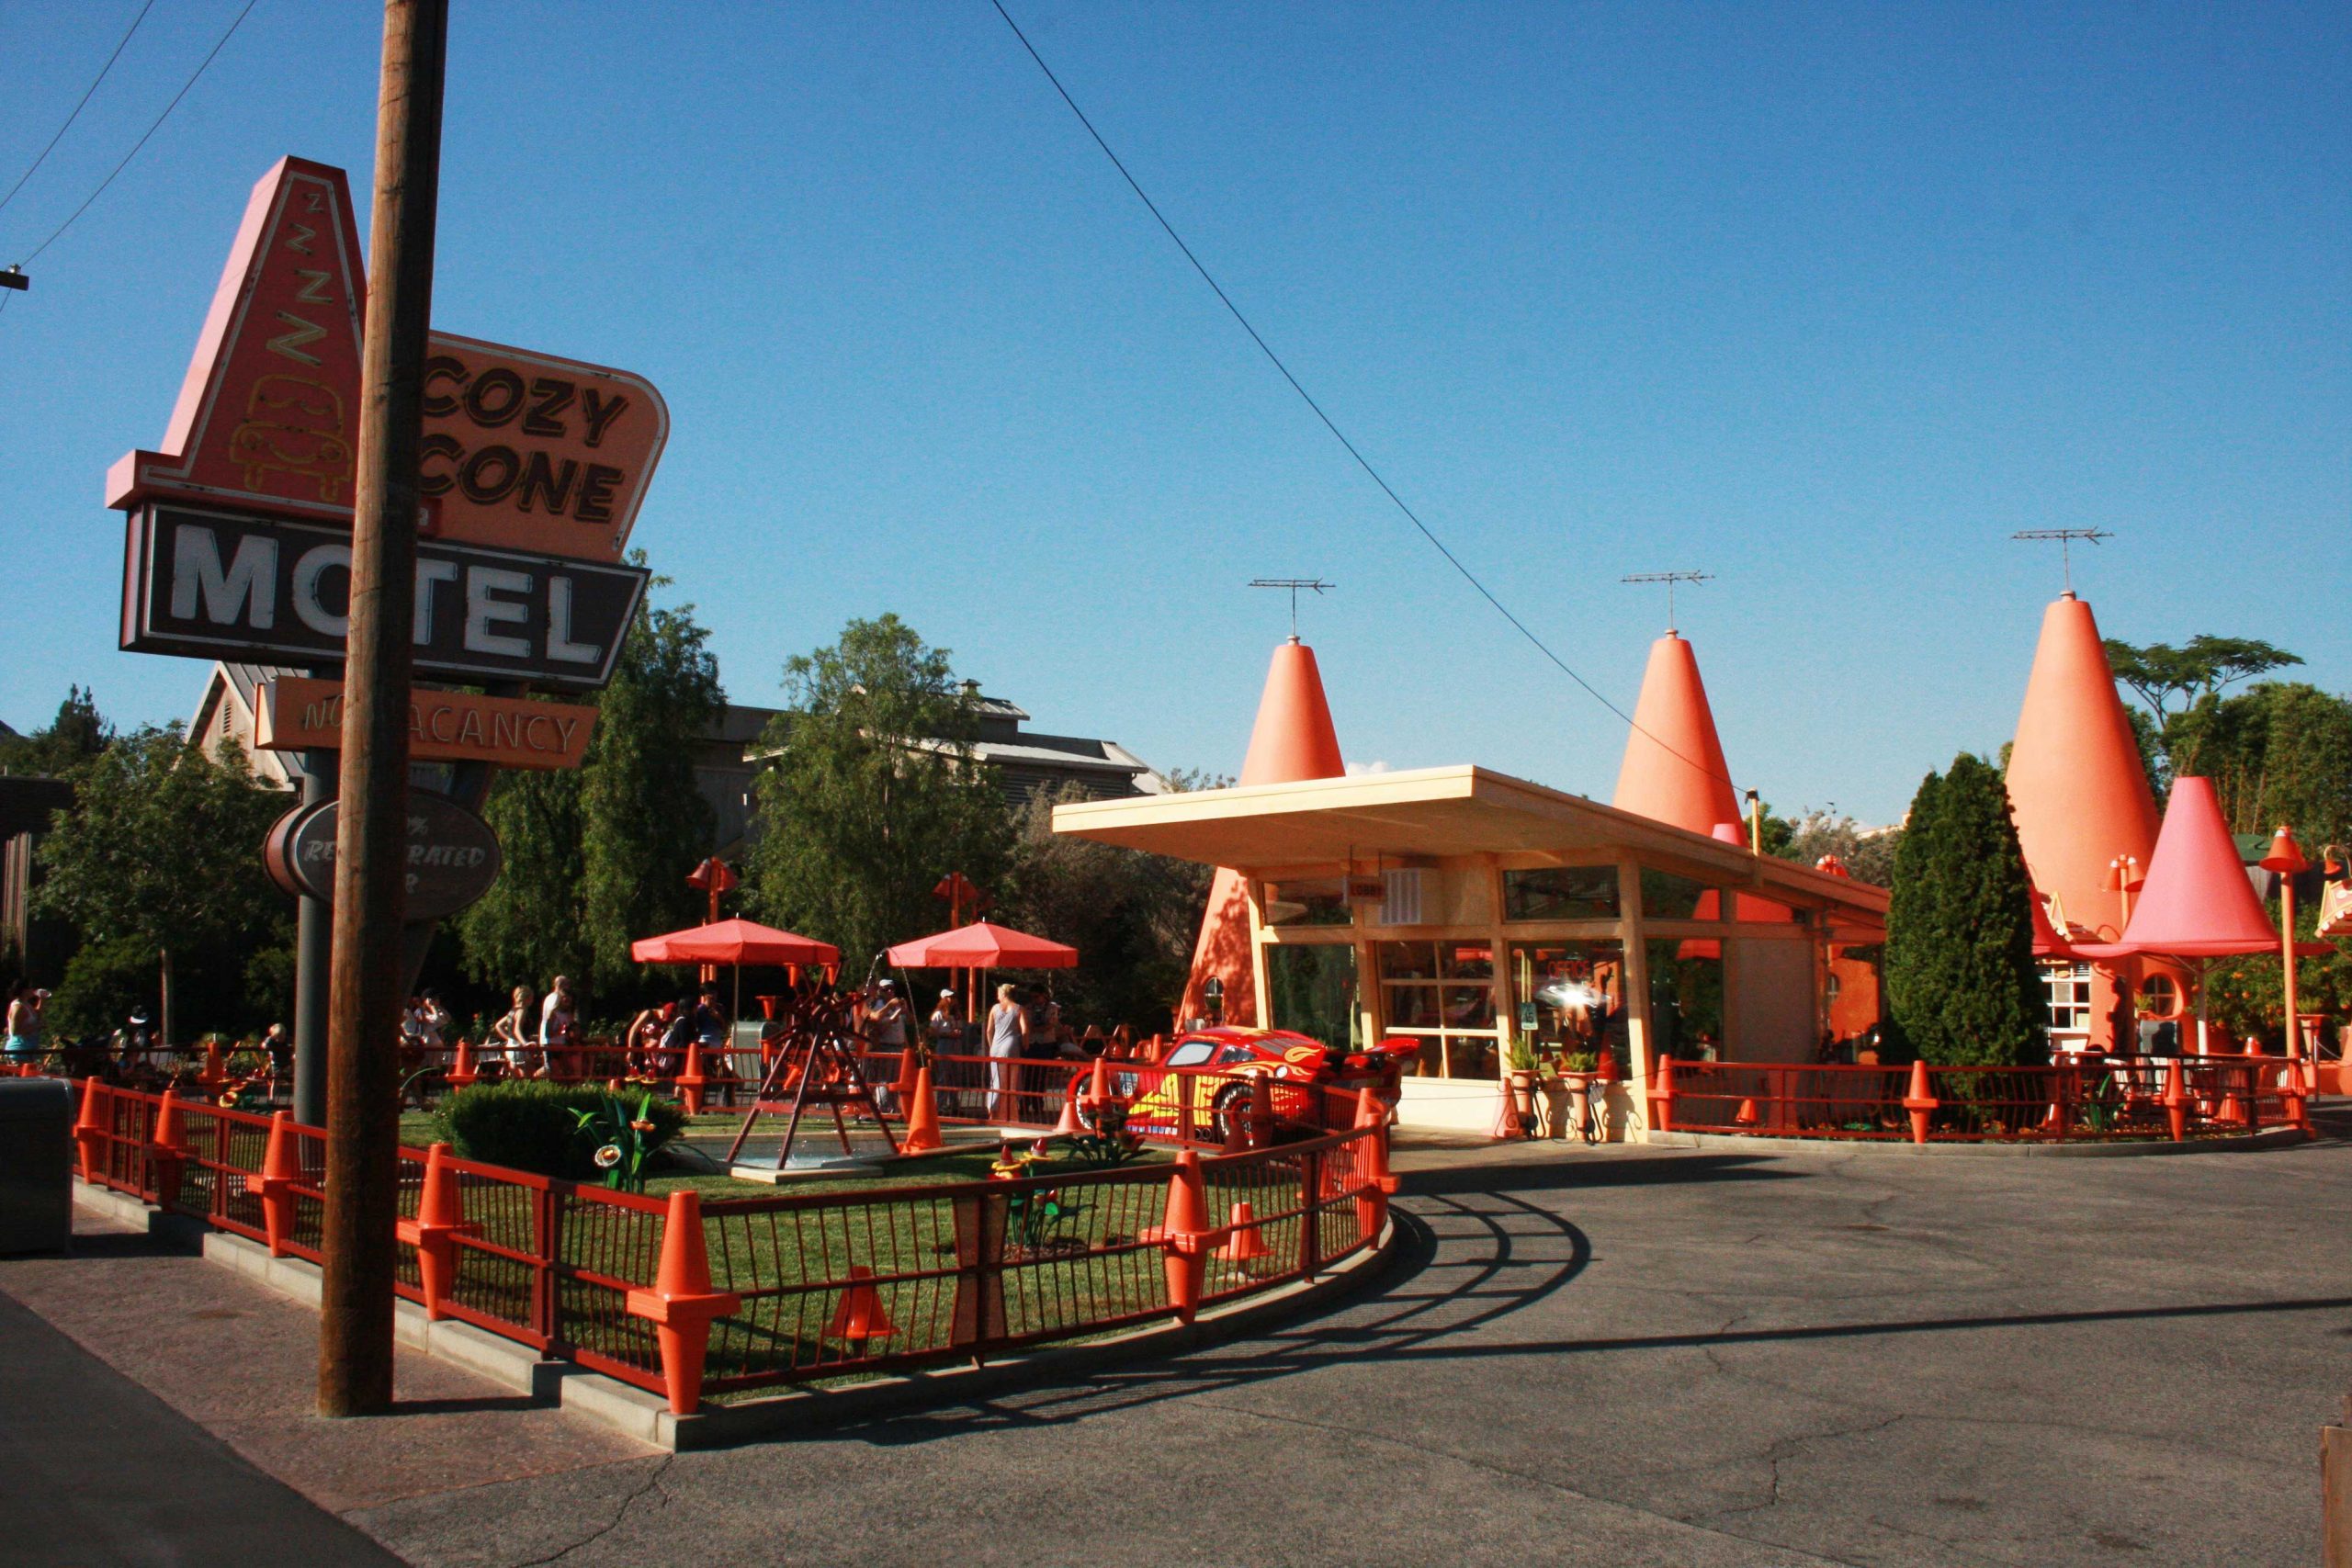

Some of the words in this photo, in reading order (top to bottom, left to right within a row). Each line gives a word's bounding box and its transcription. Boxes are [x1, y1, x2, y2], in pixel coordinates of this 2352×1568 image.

[424, 355, 629, 448] COZY
[419, 433, 626, 524] CONE
[171, 523, 602, 665] MOTEL
[410, 703, 577, 754] ACANCY
[1350, 884, 1385, 897] LOBBY
[1547, 960, 1589, 979] OFFICE
